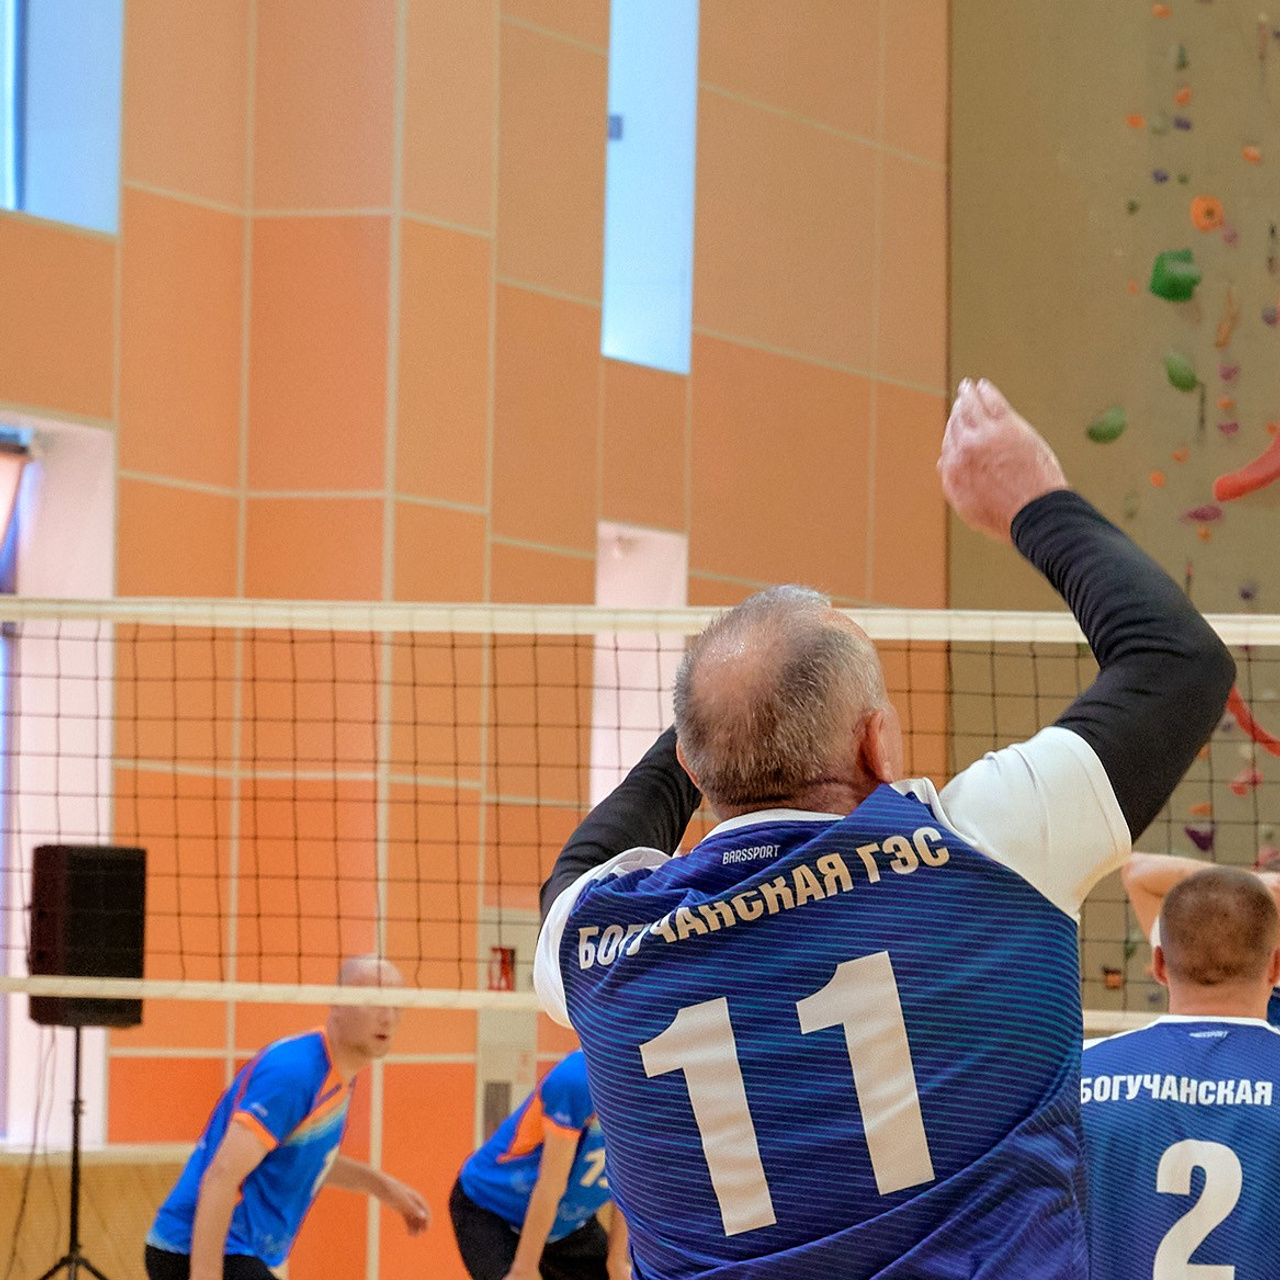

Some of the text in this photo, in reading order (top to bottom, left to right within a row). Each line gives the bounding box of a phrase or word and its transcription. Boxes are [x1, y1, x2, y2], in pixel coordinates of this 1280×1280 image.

[722, 844, 781, 865] BARSSPORT
[856, 827, 950, 884] ГЭС
[639, 951, 935, 1237] 11
[1081, 1074, 1272, 1106] БОГУЧАНСКАЯ
